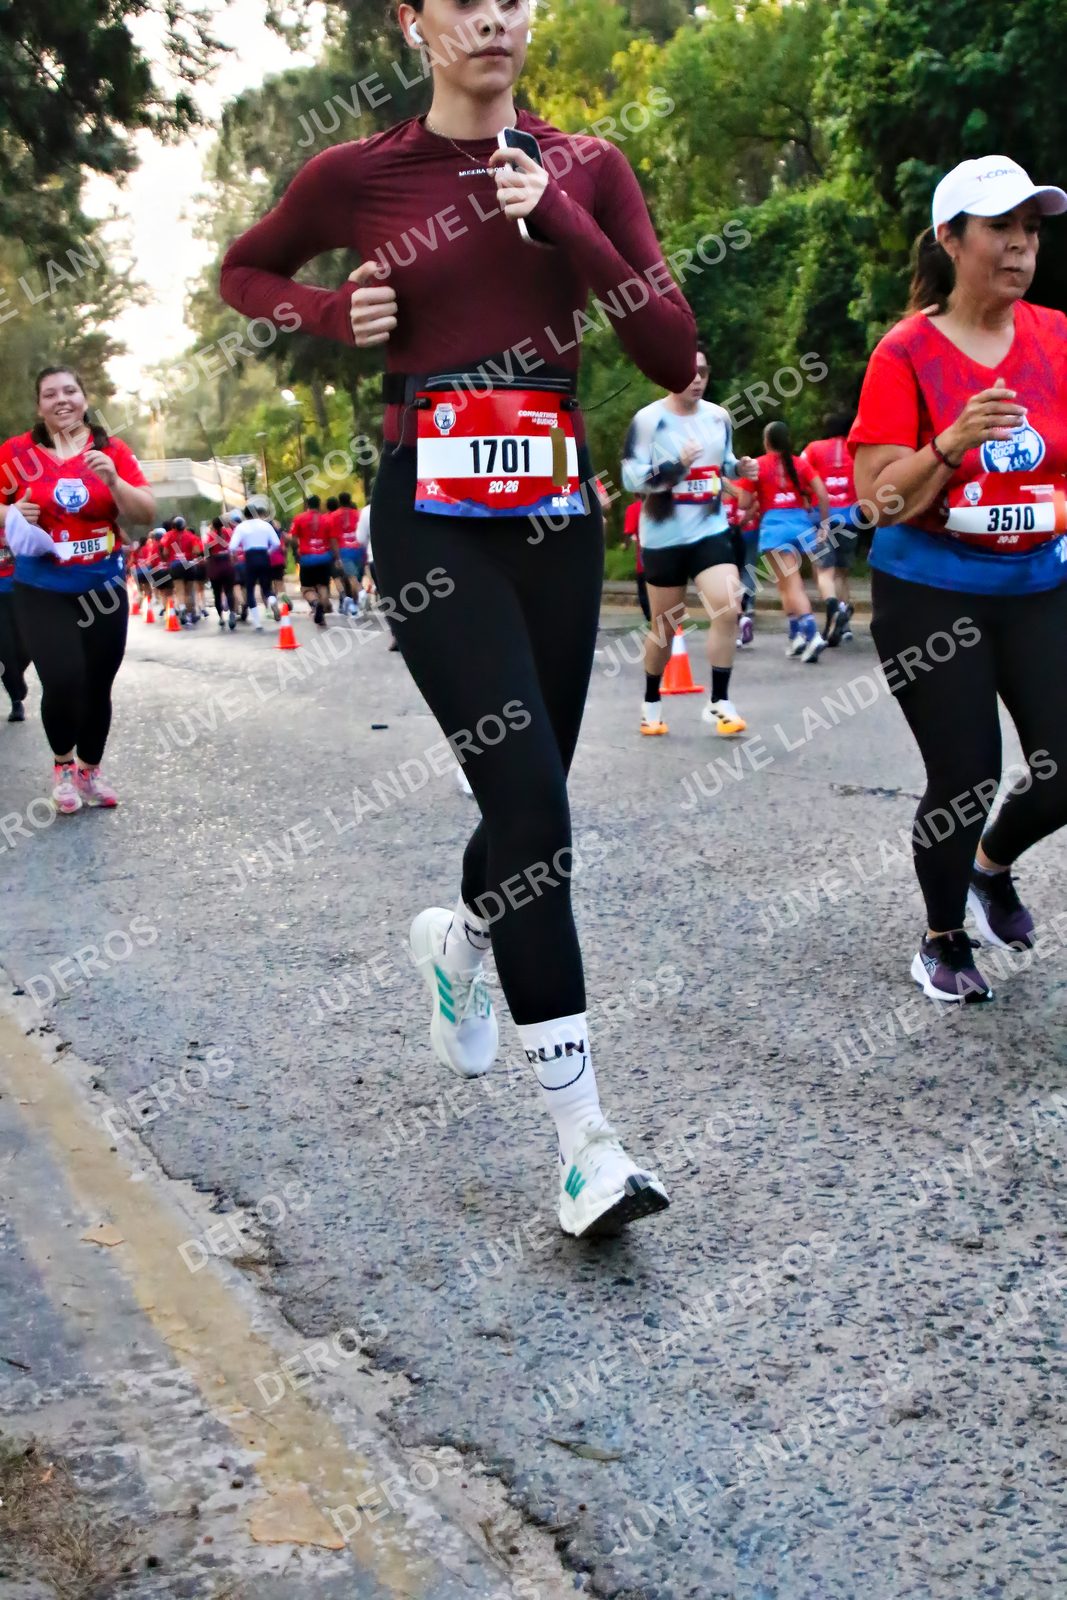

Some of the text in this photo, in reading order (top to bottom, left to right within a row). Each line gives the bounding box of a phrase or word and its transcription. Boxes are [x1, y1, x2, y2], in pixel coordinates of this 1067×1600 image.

[470, 438, 530, 474] 1701
[551, 497, 568, 507] 5K
[987, 506, 1035, 532] 3510
[72, 539, 101, 555] 2985
[525, 1039, 585, 1064] RUN
